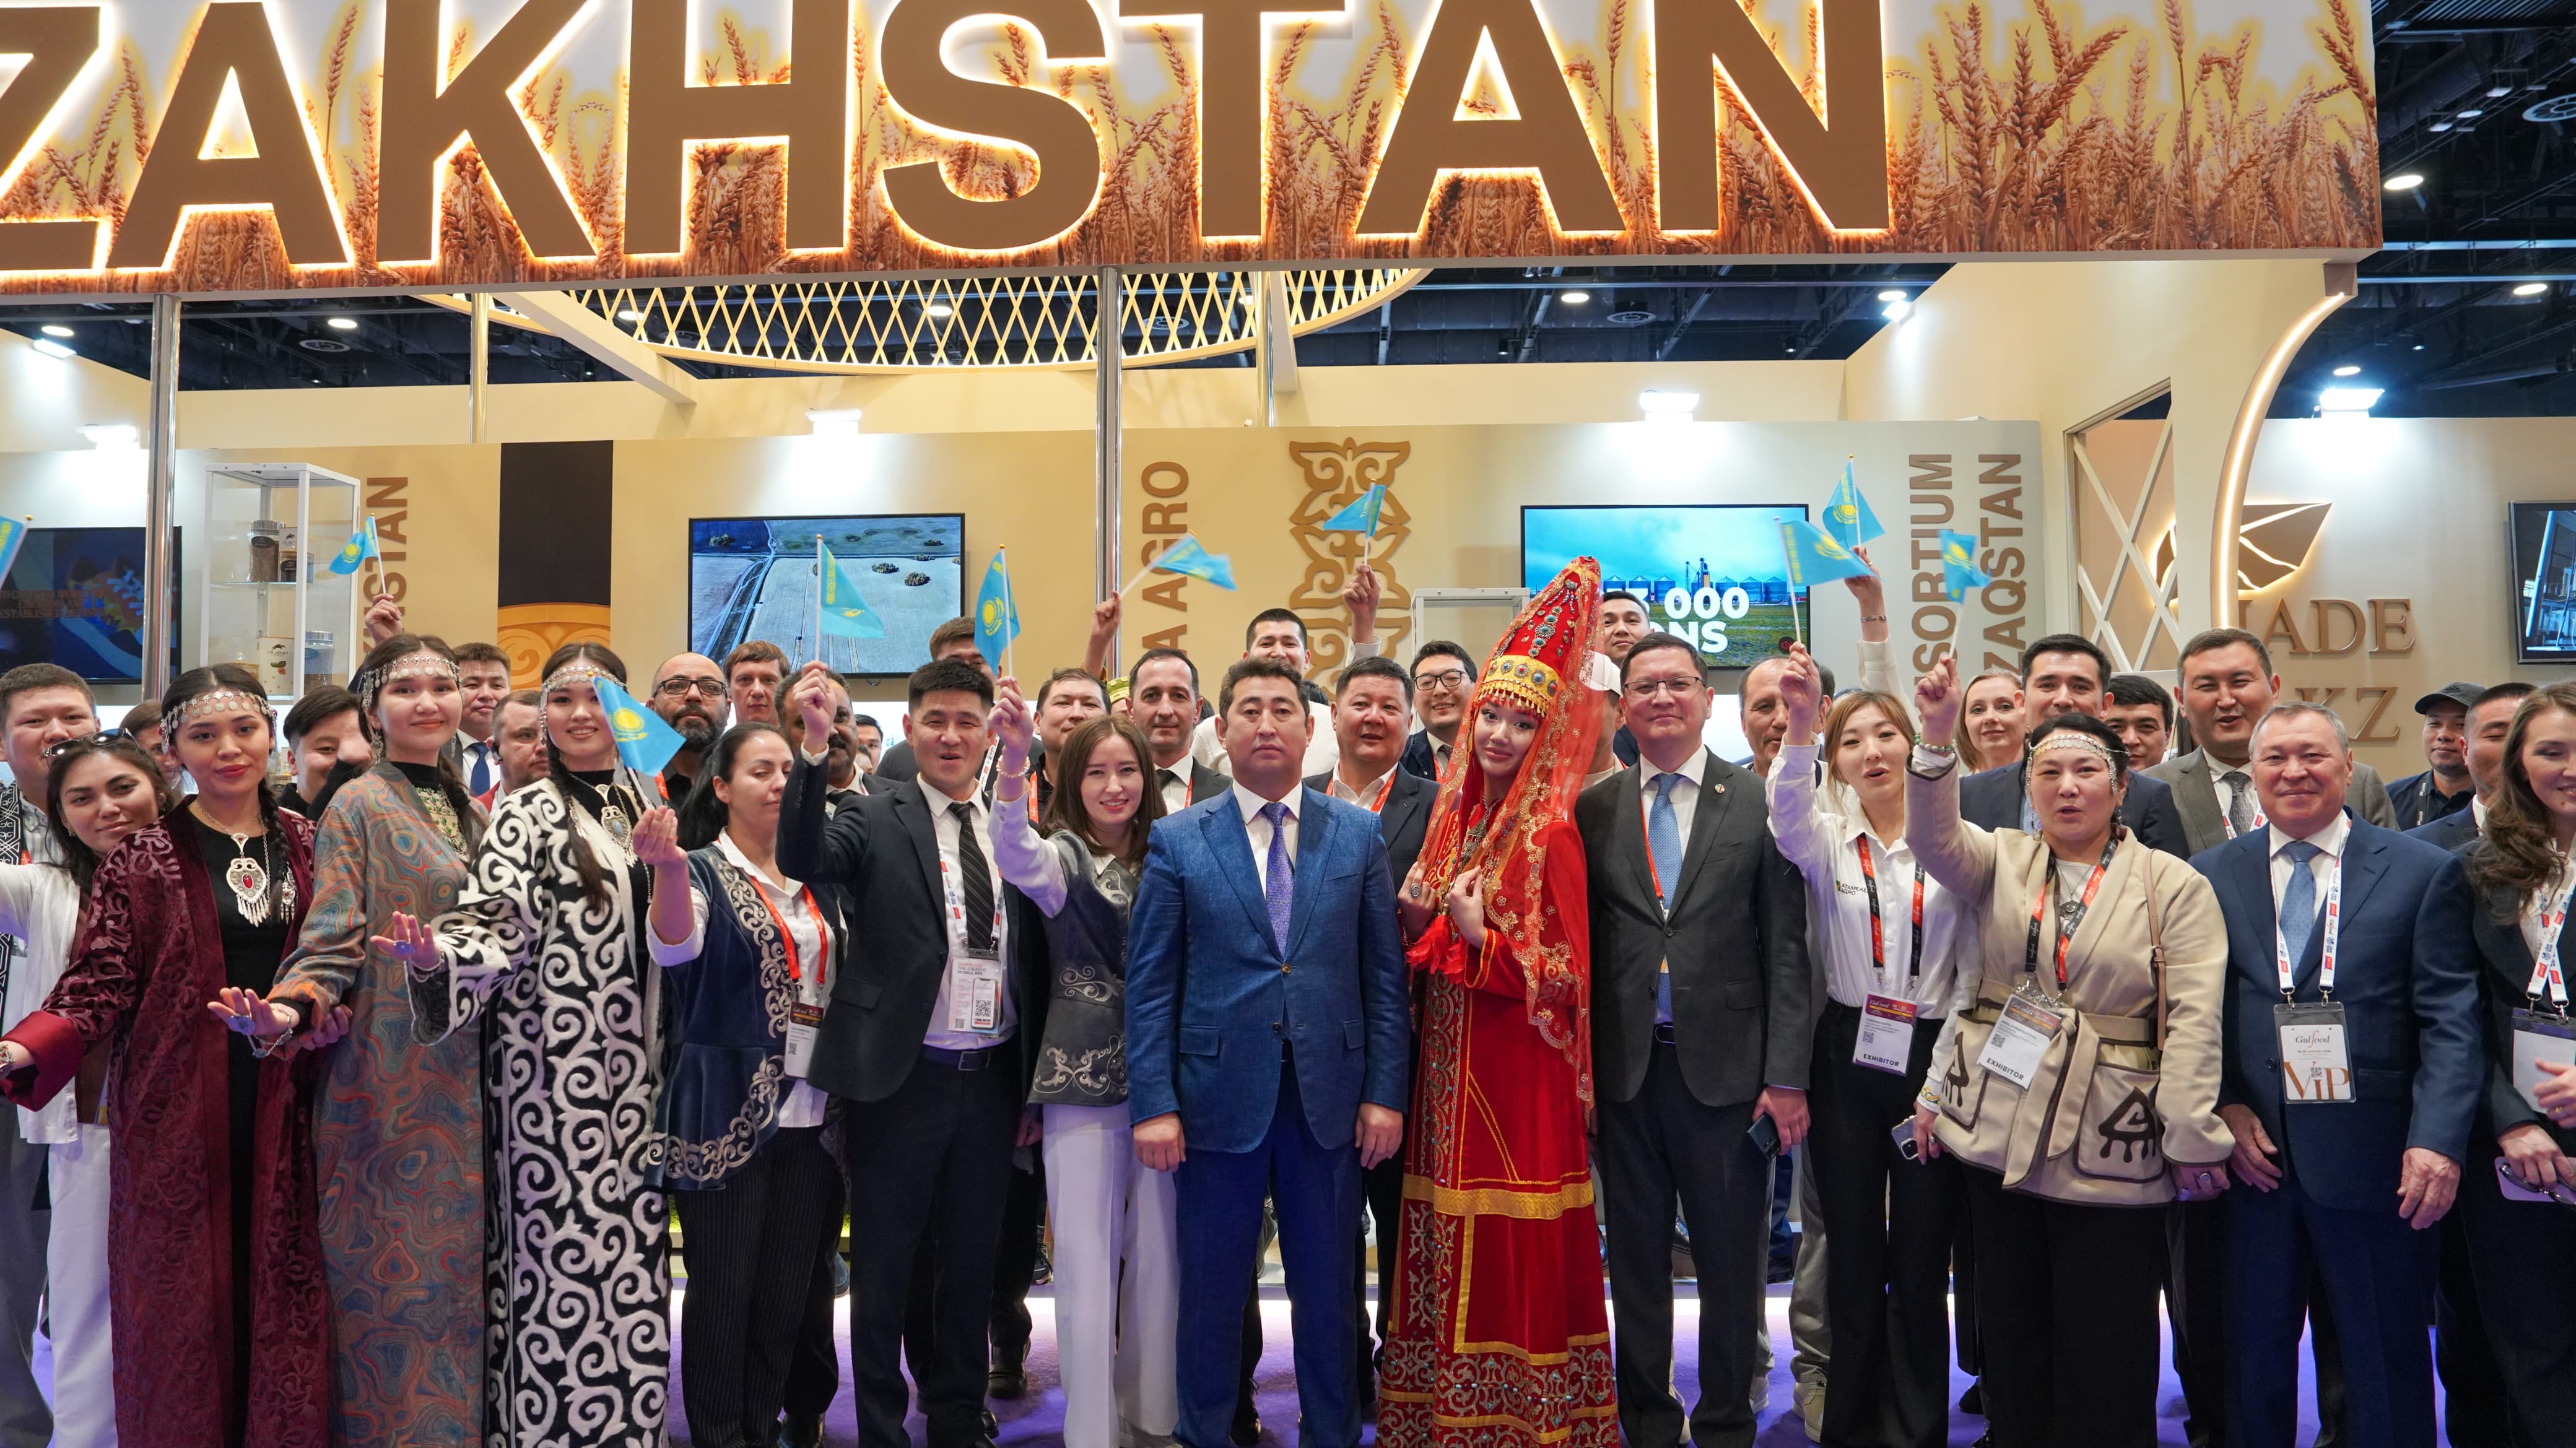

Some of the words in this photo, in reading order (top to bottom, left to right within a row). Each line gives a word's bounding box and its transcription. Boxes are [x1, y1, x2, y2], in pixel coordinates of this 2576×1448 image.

[1141, 461, 1189, 613] AGRO
[1909, 454, 1958, 685] SORTIUM
[1664, 587, 1750, 619] 000
[2295, 1030, 2330, 1048] Gulfood
[1863, 1053, 1900, 1068] EXHIBITOR
[1986, 1057, 2024, 1080] EXHIBITOR
